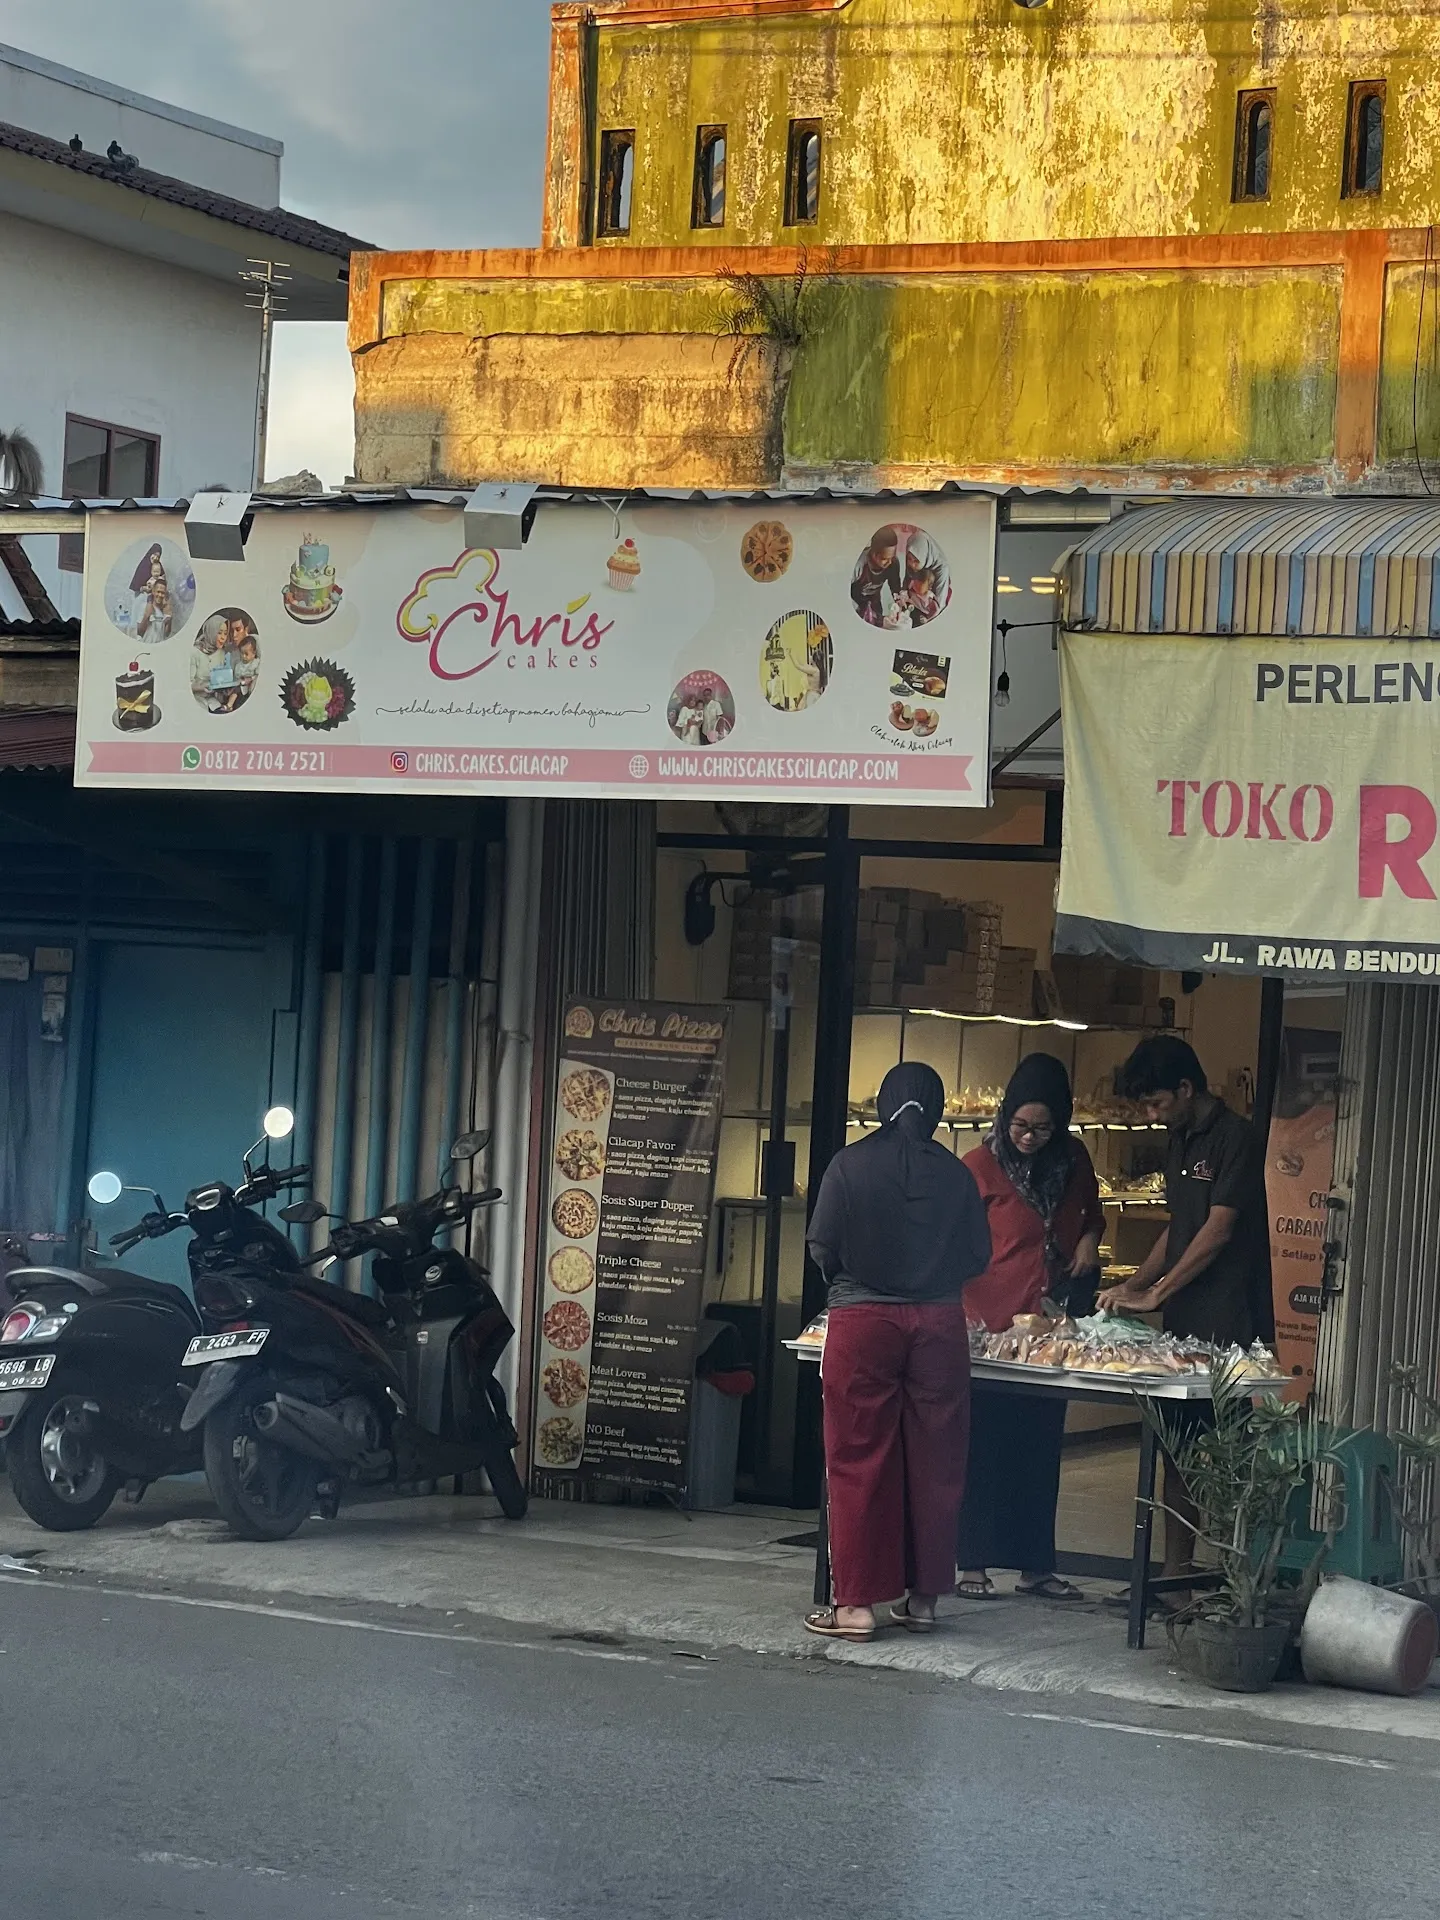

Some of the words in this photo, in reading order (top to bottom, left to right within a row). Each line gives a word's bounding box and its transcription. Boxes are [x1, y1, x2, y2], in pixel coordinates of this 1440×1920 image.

[430, 590, 615, 680] Chris
[506, 648, 598, 669] cakes
[1256, 662, 1440, 704] PERLEN
[205, 750, 240, 769] 0812
[246, 751, 284, 770] 2704
[290, 751, 325, 771] 2521
[1156, 780, 1334, 842] TOKO
[1202, 942, 1245, 965] JL.
[1257, 944, 1336, 970] RAWA
[598, 1008, 656, 1036] Chris
[660, 1012, 722, 1039] Pizza
[616, 1078, 650, 1090] Cheese
[653, 1080, 687, 1094] Burger
[608, 1136, 644, 1149] Cilacap
[646, 1140, 676, 1150] Favor
[602, 1195, 626, 1206] Sosis
[628, 1197, 659, 1210] Super
[660, 1200, 694, 1212] Dupper
[598, 1254, 628, 1268] Triple
[630, 1256, 662, 1269] Cheese
[1294, 1294, 1308, 1303] AJA
[597, 1312, 623, 1324] Sosis
[624, 1314, 648, 1326] Moza
[190, 1340, 200, 1352] R
[206, 1334, 236, 1350] 2463
[247, 1332, 267, 1343] FP
[34, 1358, 50, 1372] LB
[591, 1365, 614, 1376] Meat
[616, 1368, 647, 1380] Lovers
[587, 1424, 602, 1434] NO
[604, 1426, 625, 1438] Beef
